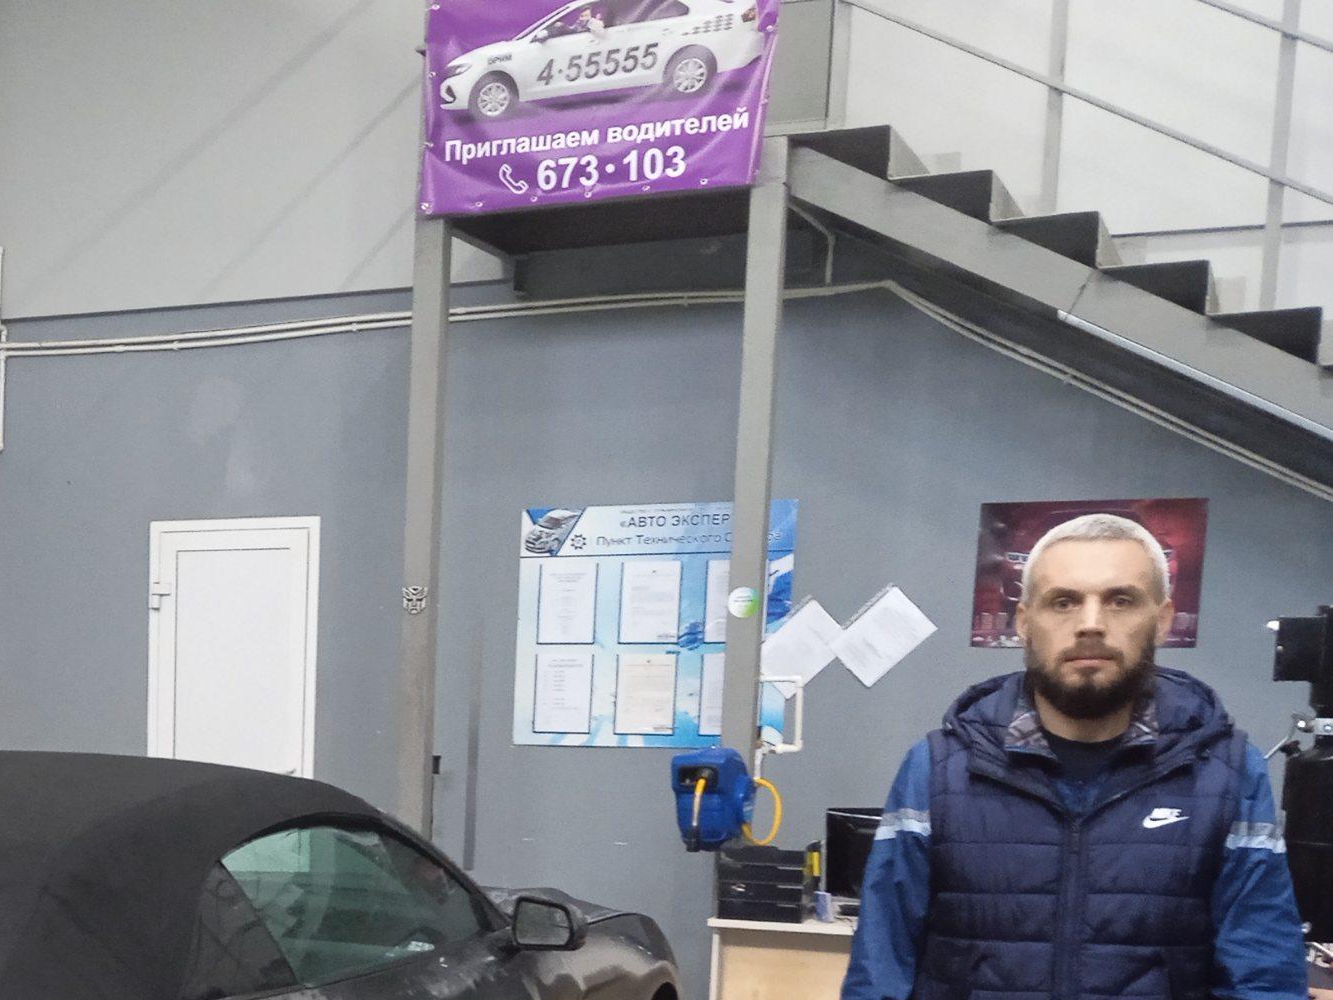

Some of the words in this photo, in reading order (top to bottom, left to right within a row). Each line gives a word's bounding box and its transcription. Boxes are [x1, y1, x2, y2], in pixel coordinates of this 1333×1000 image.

[445, 126, 600, 164] Приглашаем
[606, 106, 749, 142] водителей
[671, 513, 730, 526] ЭКСПЕР
[596, 536, 632, 547] Пункт
[636, 532, 721, 545] Технического
